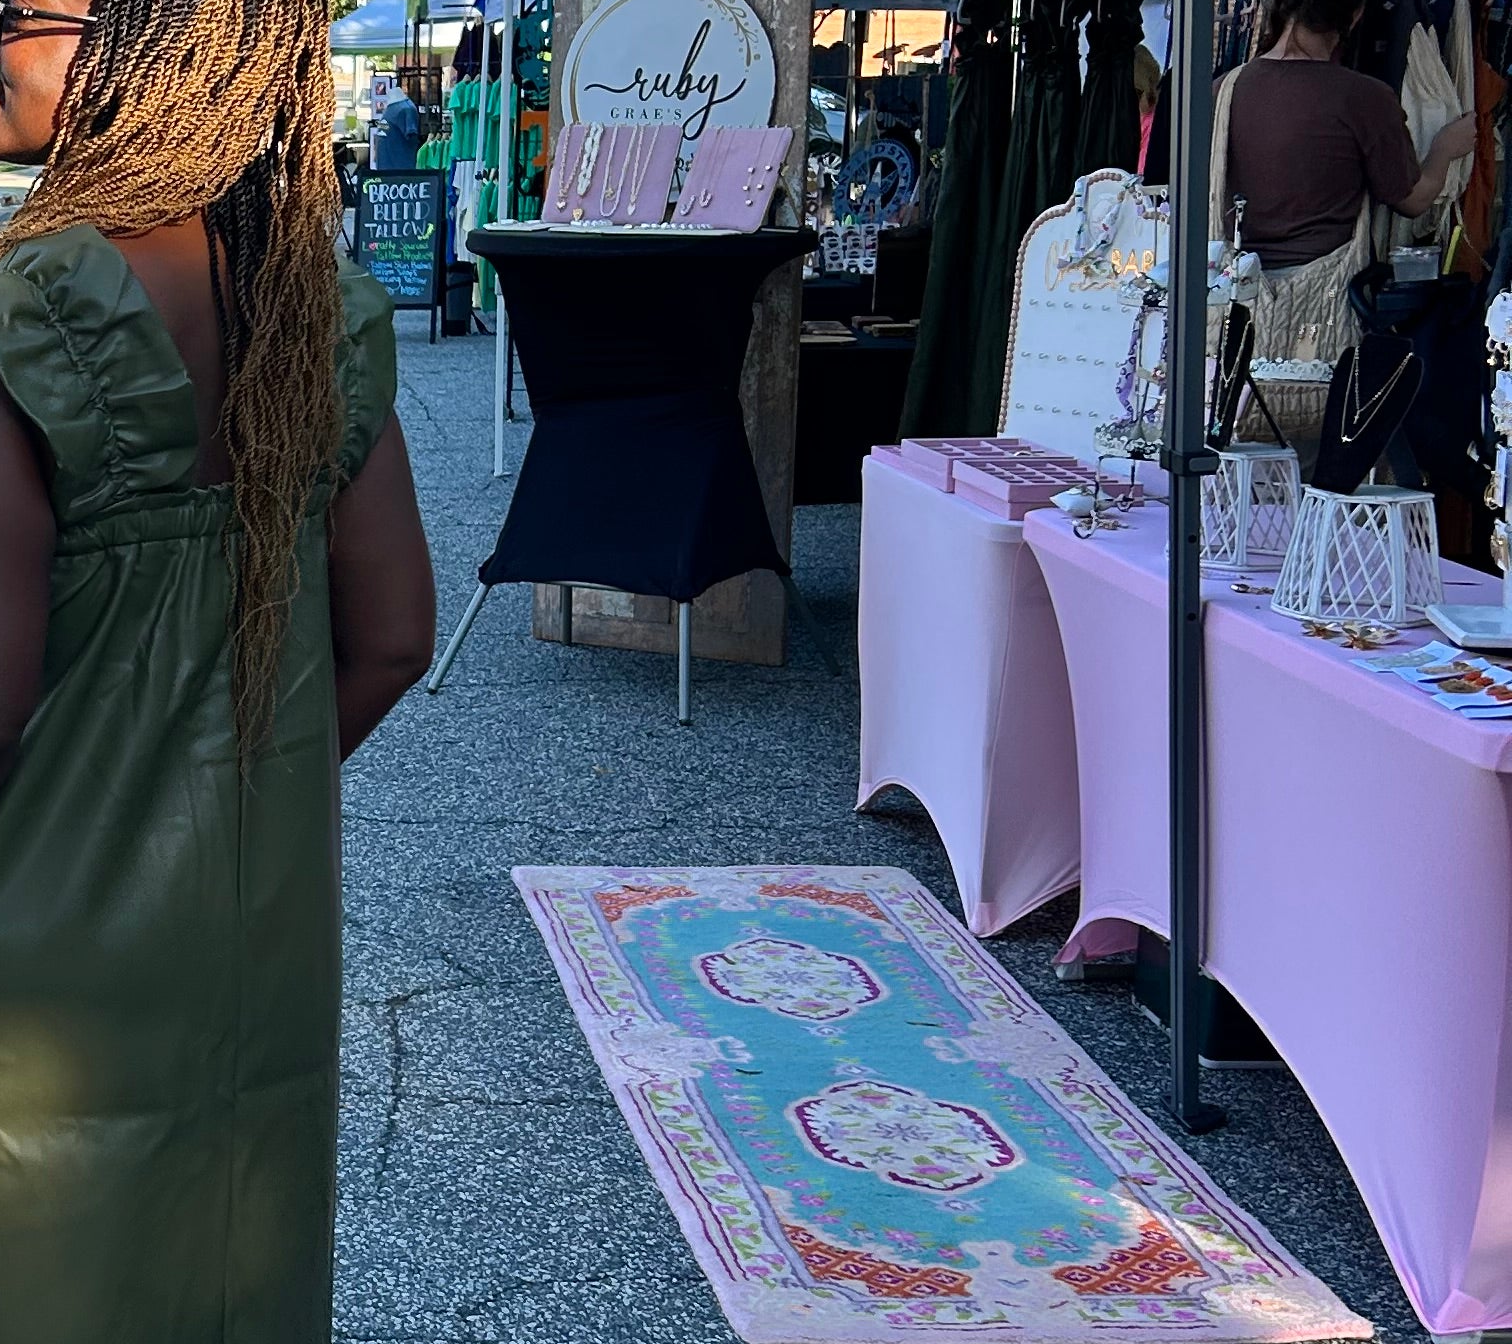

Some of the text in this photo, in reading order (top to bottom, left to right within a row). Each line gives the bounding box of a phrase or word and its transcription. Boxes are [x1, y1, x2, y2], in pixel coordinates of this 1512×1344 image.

[584, 19, 746, 140] ruby
[609, 107, 683, 121] GRAE'S
[368, 182, 432, 204] BROOKE
[373, 201, 431, 221] BLEND
[364, 221, 427, 239] TALLOW
